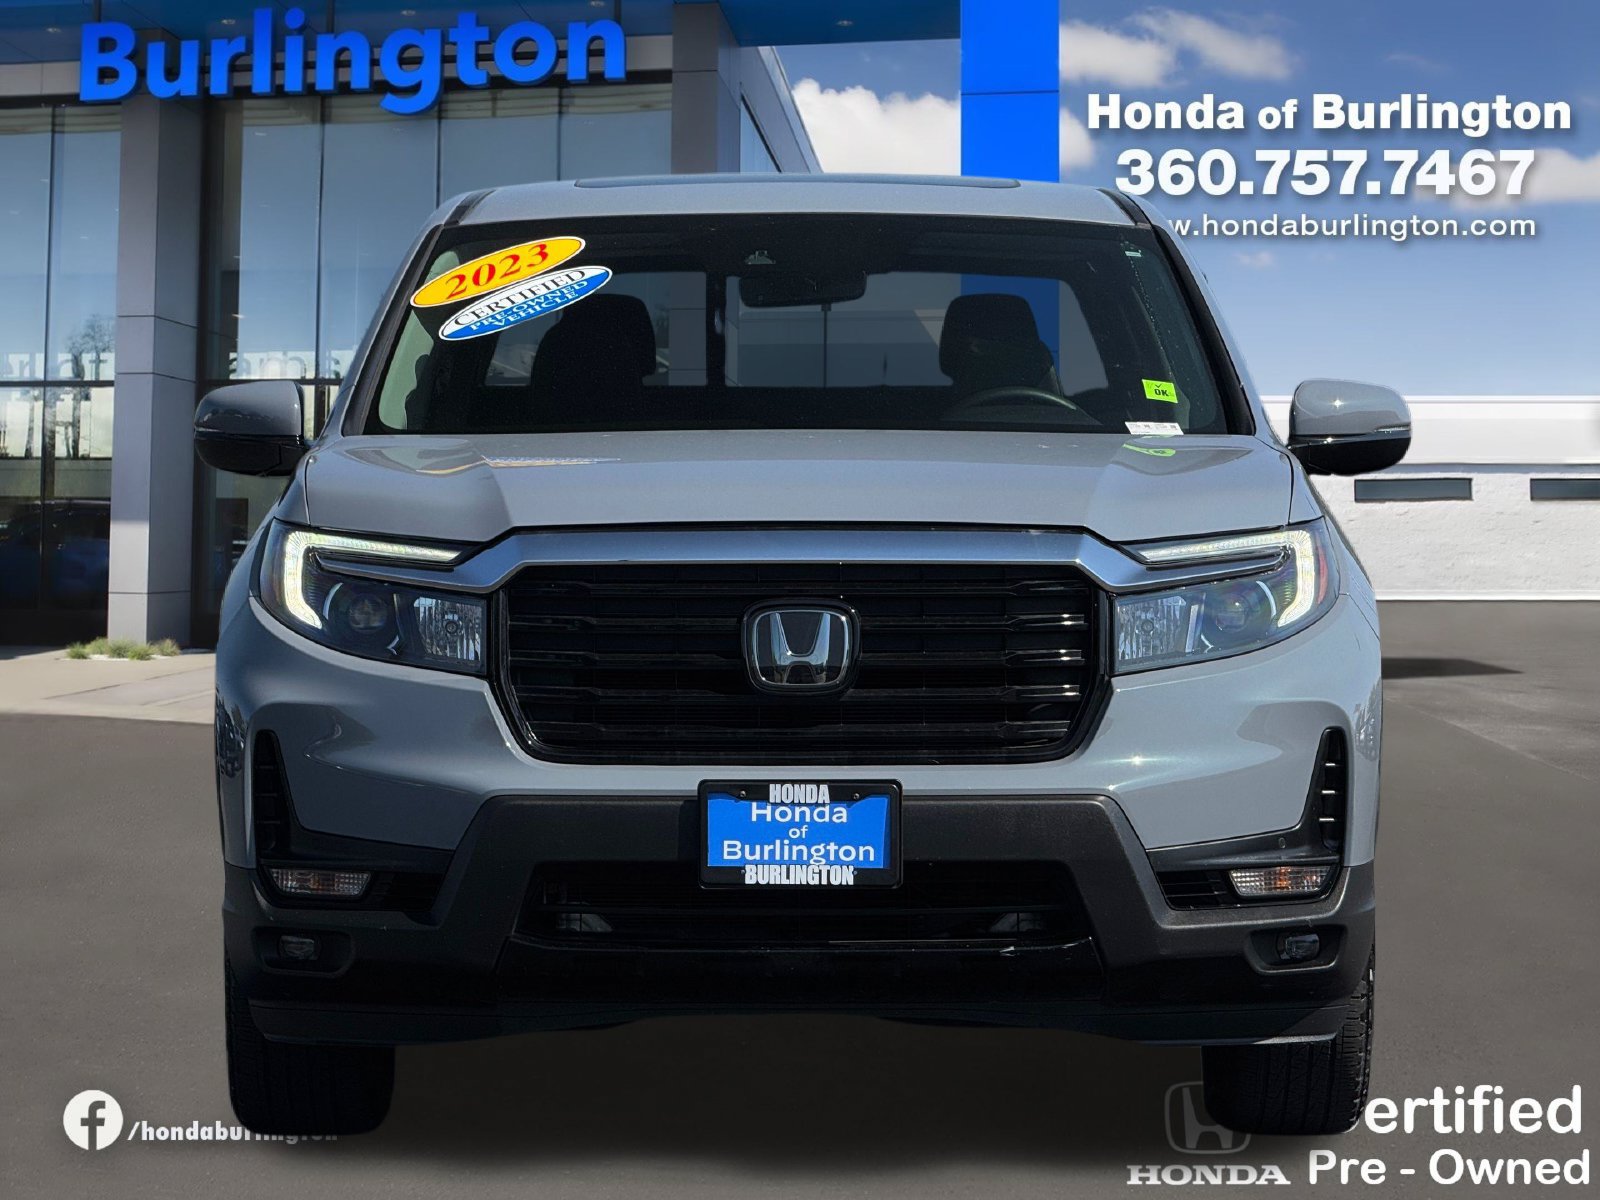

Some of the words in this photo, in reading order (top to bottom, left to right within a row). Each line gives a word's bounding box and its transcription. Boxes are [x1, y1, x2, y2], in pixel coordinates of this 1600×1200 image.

[80, 8, 626, 115] Burlington
[445, 243, 549, 300] 2023
[453, 269, 586, 327] CERTIFIED
[469, 280, 588, 331] PRE-OWNED
[492, 288, 579, 327] VEHICLE
[1154, 388, 1169, 397] OK
[768, 783, 831, 804] HONDA
[751, 801, 848, 823] Honda
[788, 825, 809, 839] of
[723, 839, 875, 866] Burlington
[744, 864, 856, 885] BURLINGTON
